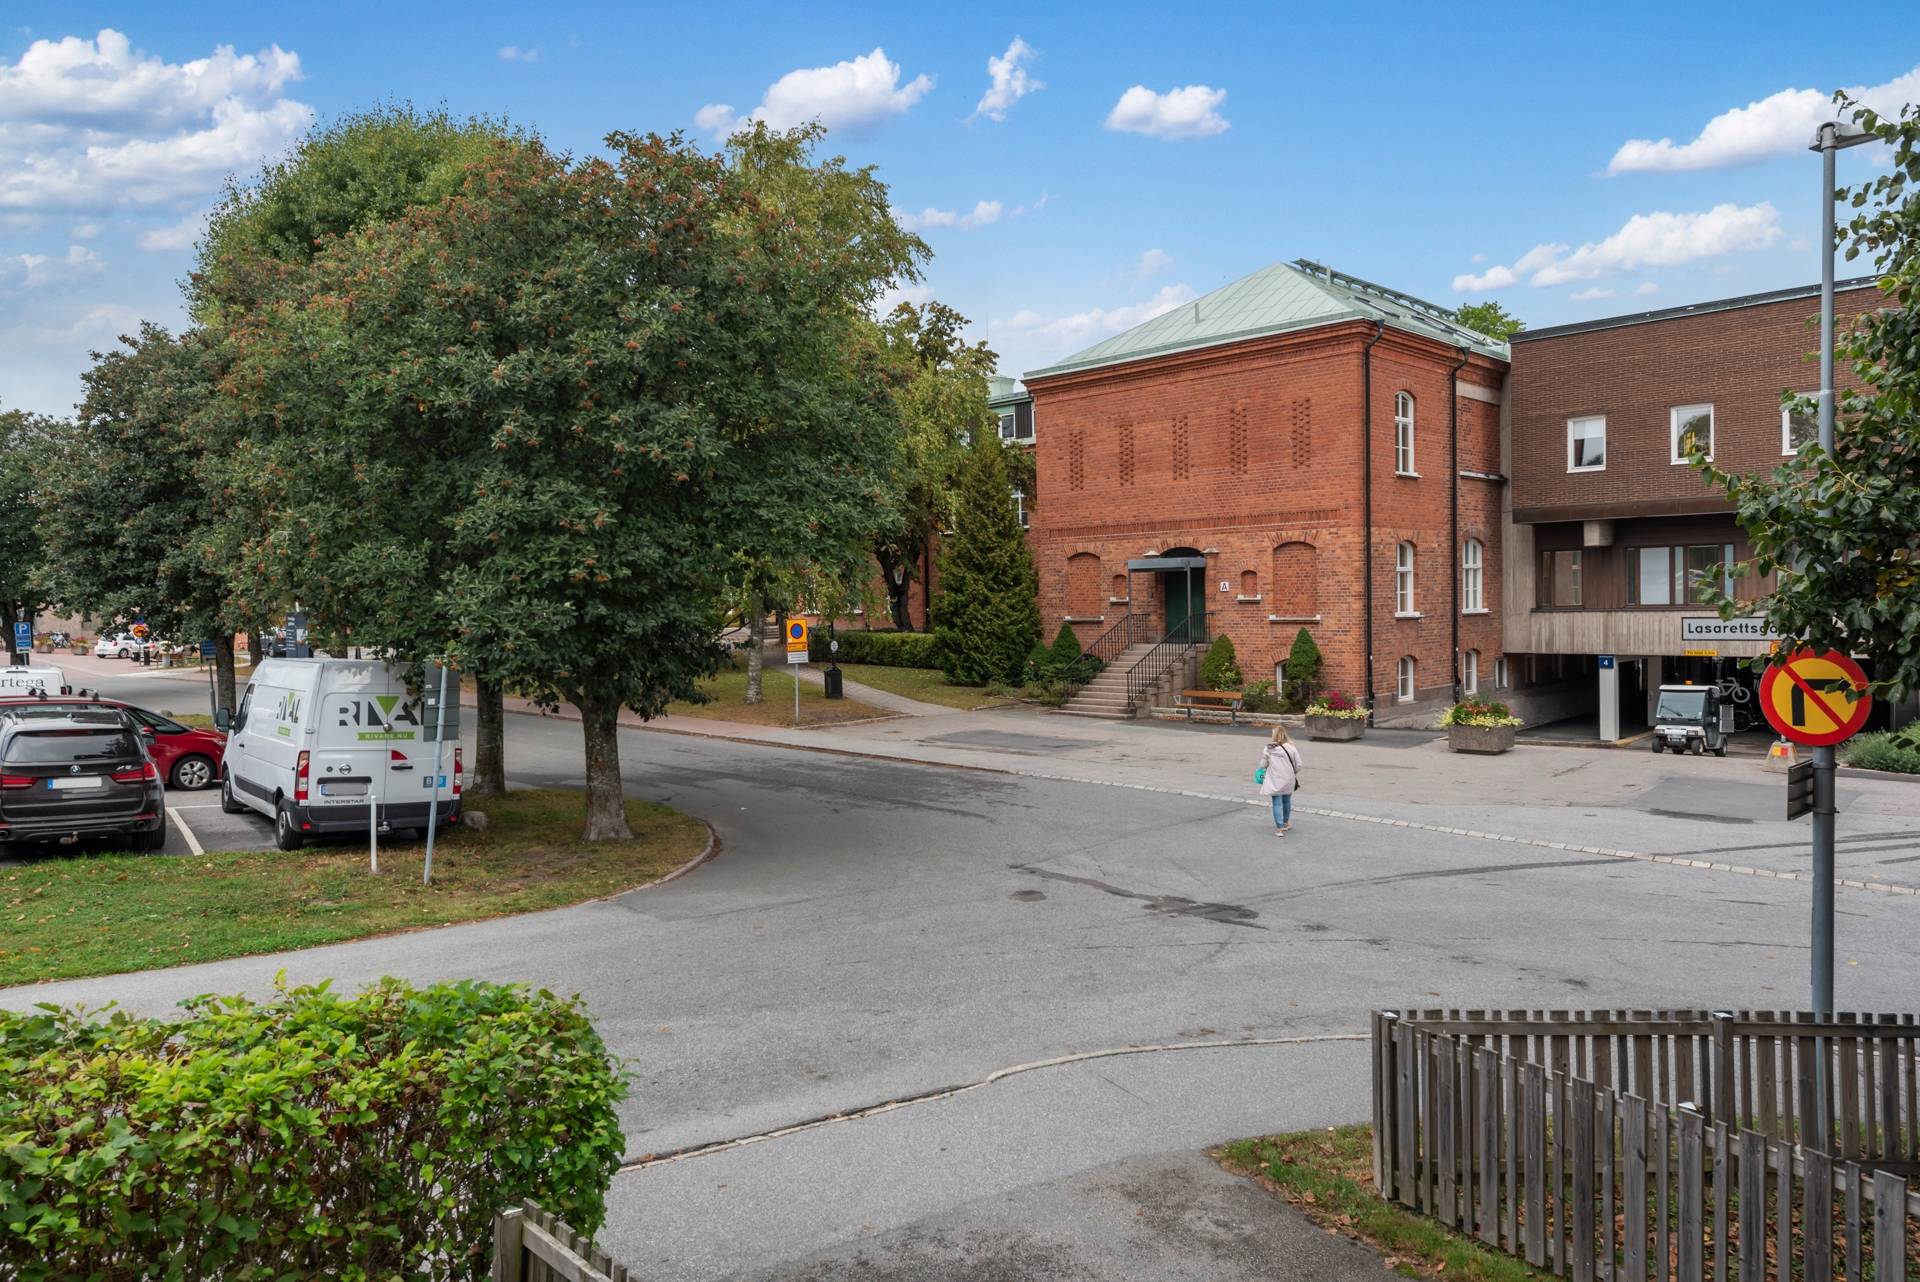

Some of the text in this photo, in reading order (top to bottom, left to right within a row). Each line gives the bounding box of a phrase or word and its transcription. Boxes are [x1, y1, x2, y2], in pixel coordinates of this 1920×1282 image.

[1222, 582, 1227, 590] A
[19, 624, 28, 634] P
[1688, 623, 1778, 636] Lasarettsga
[0, 678, 45, 688] rtega
